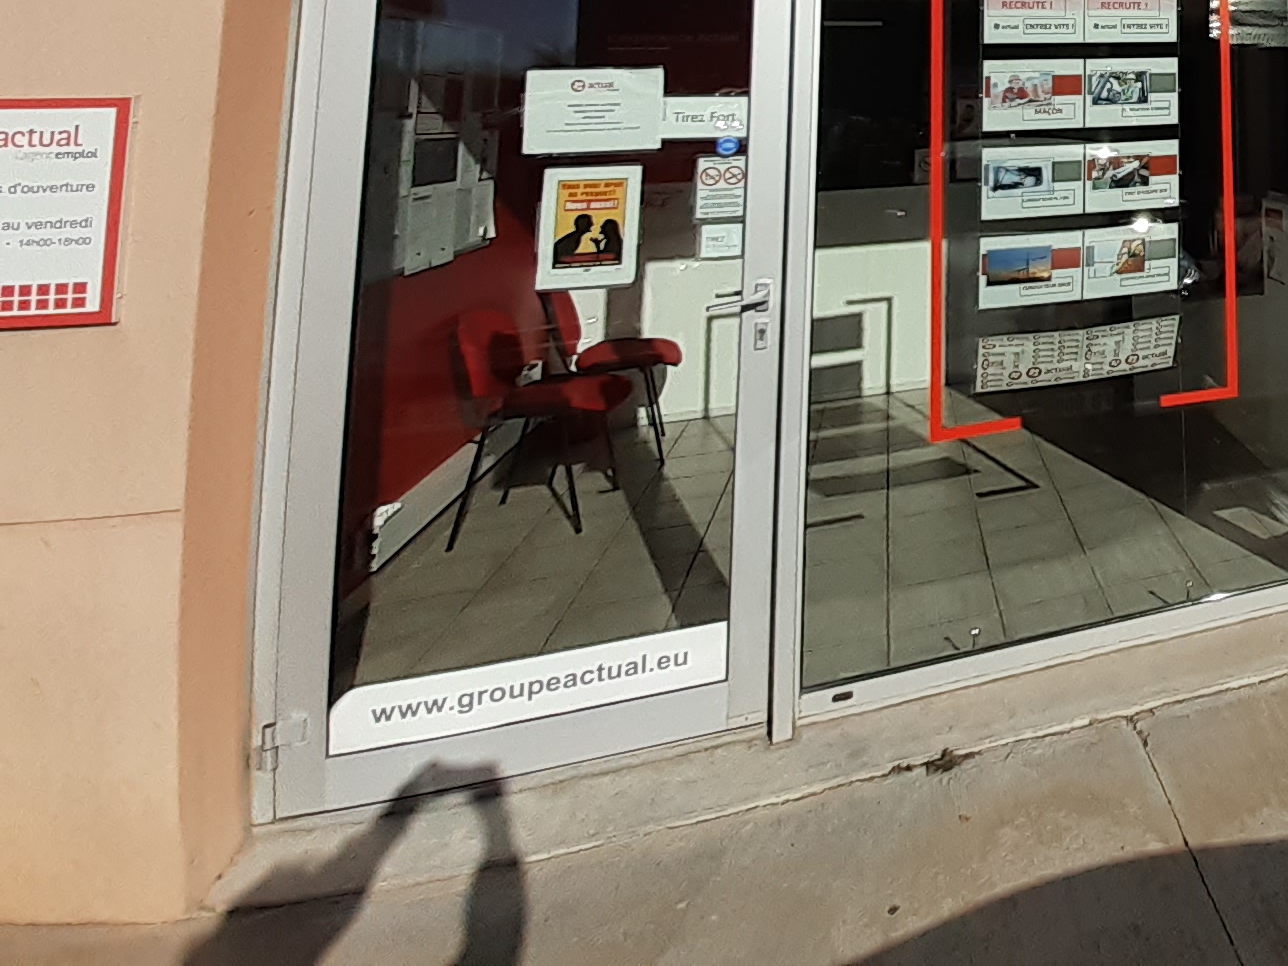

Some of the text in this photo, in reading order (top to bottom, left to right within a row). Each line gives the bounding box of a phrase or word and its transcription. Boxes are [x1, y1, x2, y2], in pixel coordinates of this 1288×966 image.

[1001, 0, 1047, 10] RECRUTE
[1100, 1, 1142, 10] RECRUTE
[673, 111, 706, 123] Tirez
[8, 182, 96, 195] d'ouverture
[1, 216, 94, 232] au vendredi
[370, 648, 690, 724] www.groupeactual.eu
